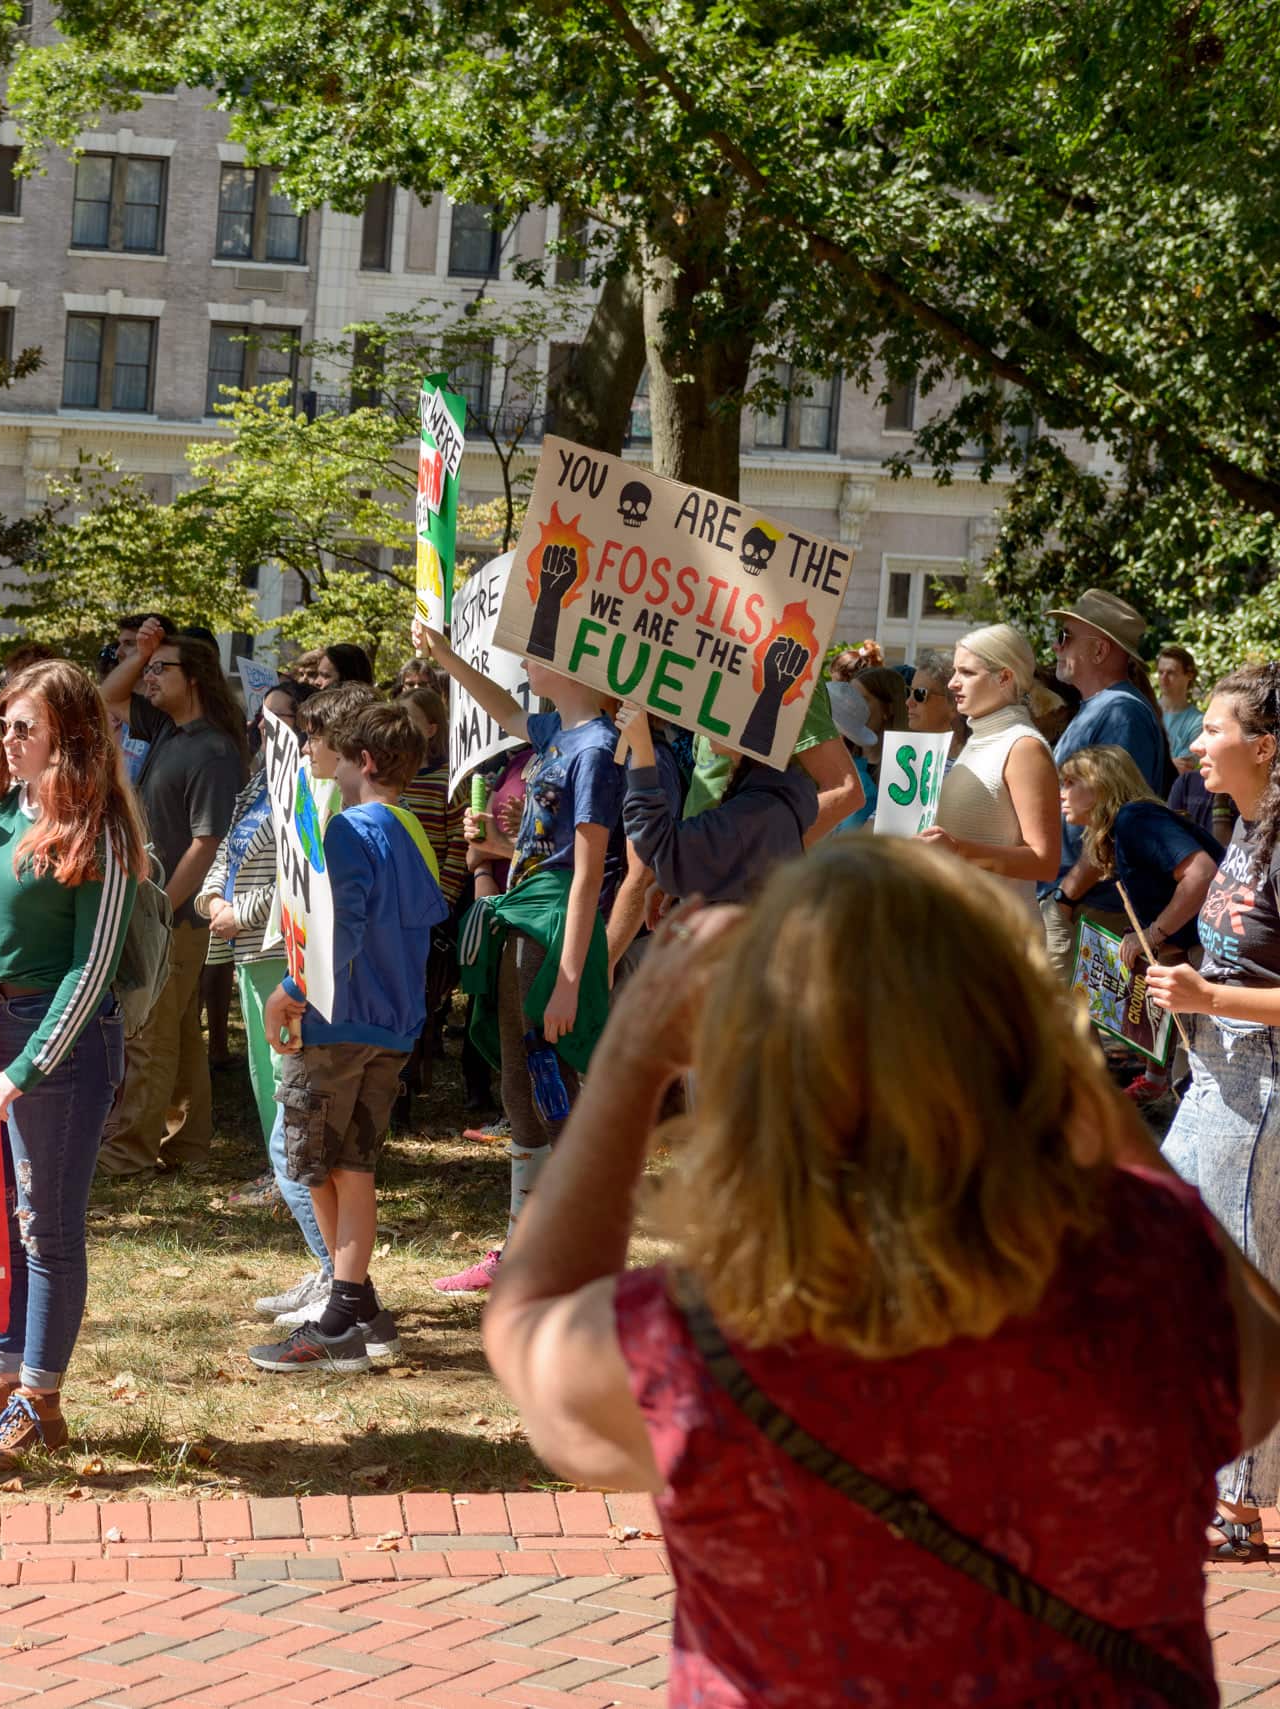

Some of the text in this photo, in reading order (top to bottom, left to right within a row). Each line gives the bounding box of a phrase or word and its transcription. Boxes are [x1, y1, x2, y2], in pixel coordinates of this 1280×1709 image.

[429, 407, 461, 475] WERE
[558, 449, 849, 596] YOU ARE THE
[589, 590, 747, 676] WE ARE THE
[595, 538, 764, 645] FOSSILS
[568, 617, 732, 738] FUEL
[280, 823, 311, 914] ON
[1088, 954, 1105, 991] KEEP
[1128, 974, 1146, 1024] GROUND
